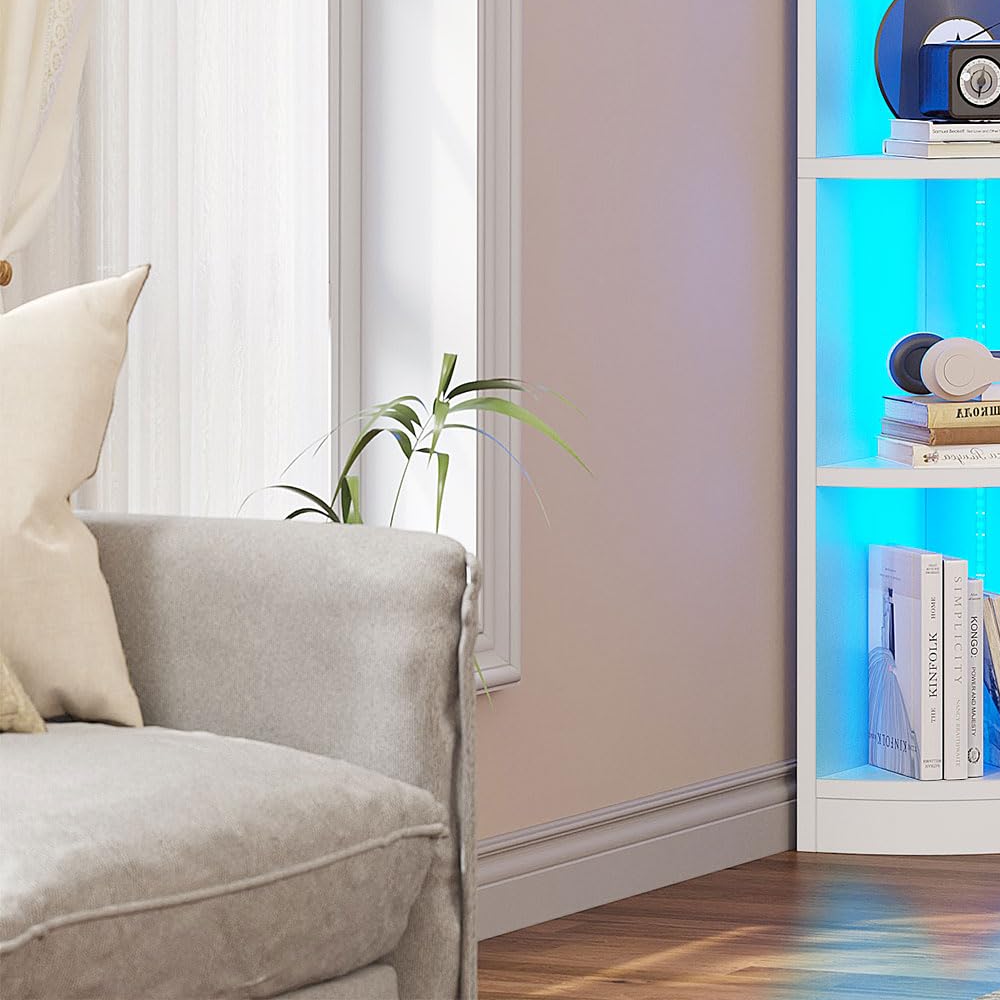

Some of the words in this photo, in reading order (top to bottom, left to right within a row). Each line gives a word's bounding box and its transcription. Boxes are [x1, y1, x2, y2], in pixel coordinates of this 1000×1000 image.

[954, 576, 962, 684] SIMPLICITY
[970, 616, 979, 658] KONGO:
[928, 632, 938, 698] KINFOLK
[877, 732, 908, 753] KINFOLK
